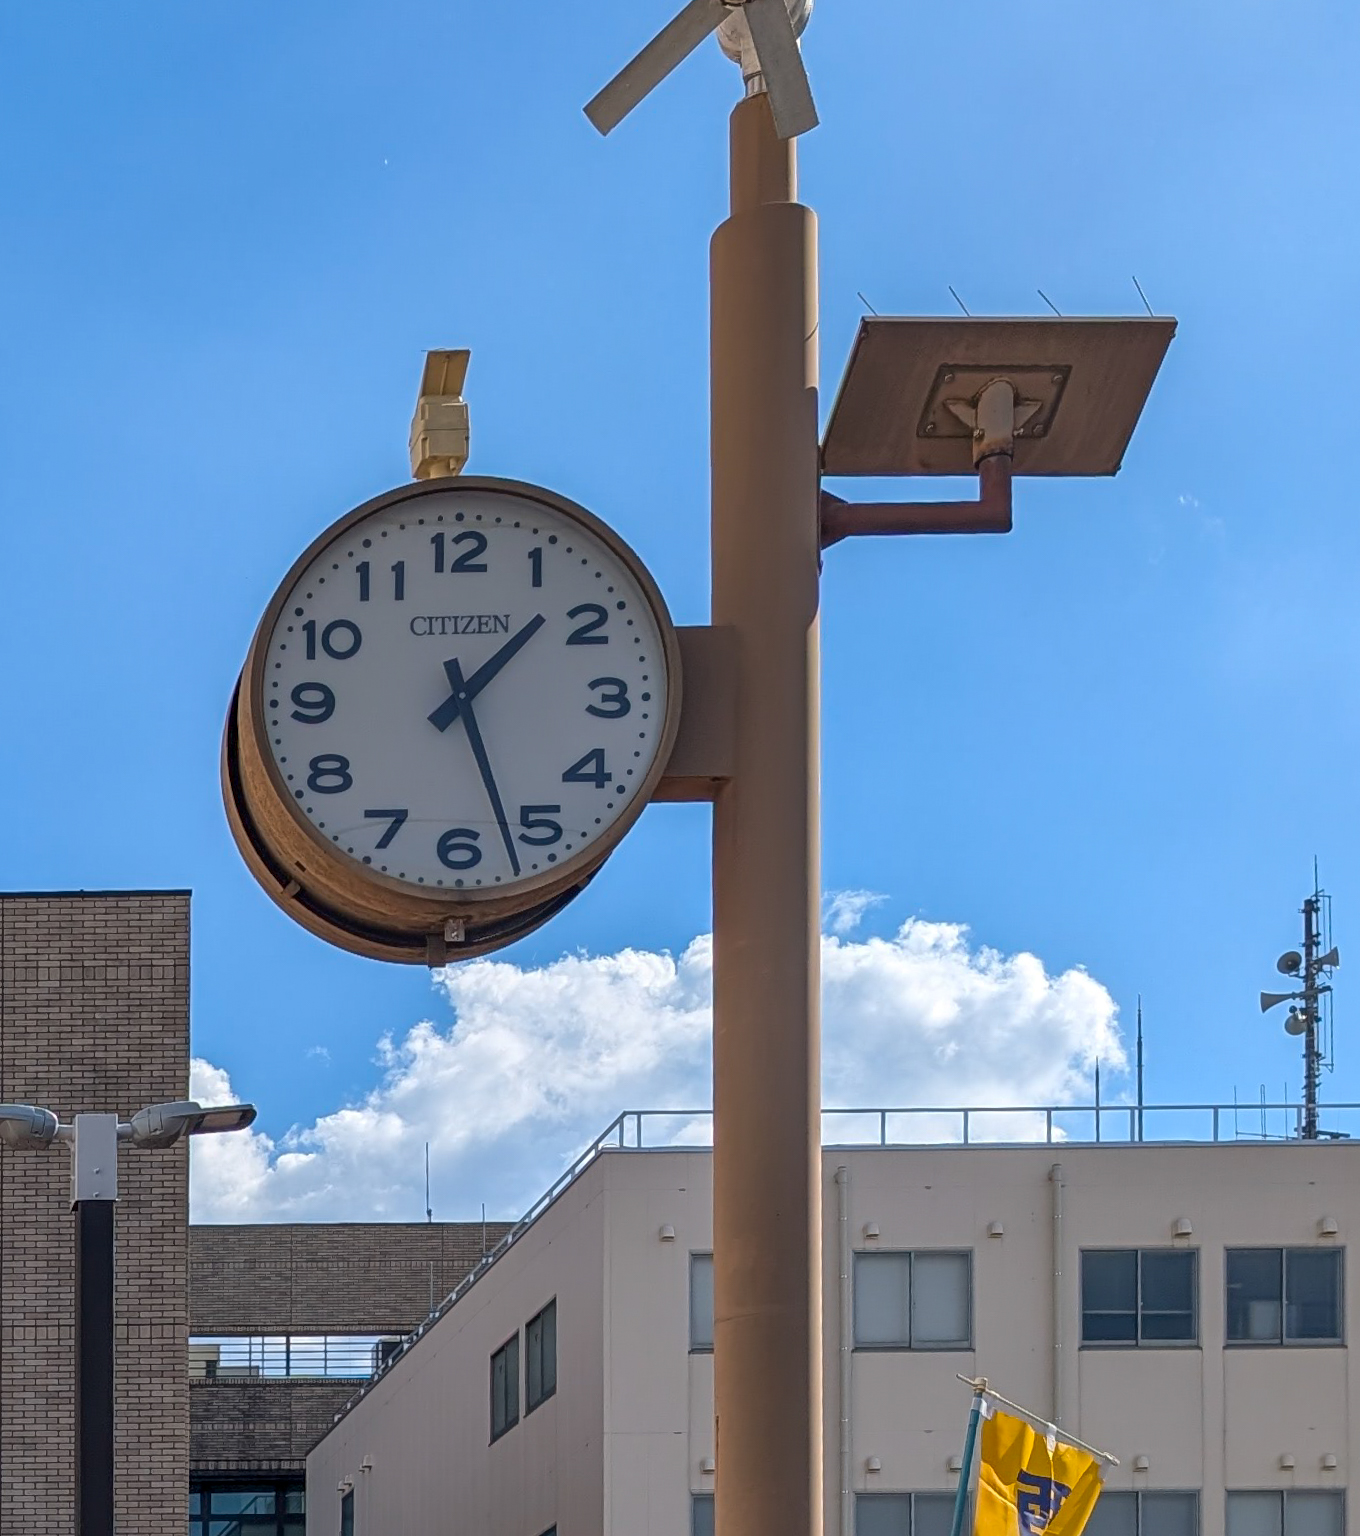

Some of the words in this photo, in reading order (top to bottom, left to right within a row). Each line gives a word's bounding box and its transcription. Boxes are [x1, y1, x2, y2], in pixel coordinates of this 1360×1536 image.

[430, 530, 488, 573] 12
[527, 547, 542, 587] 1
[355, 561, 406, 601] 11
[301, 619, 362, 660] 10
[409, 614, 511, 637] CITIZEN
[565, 603, 609, 645] 2
[290, 682, 335, 724] 9
[585, 677, 631, 719] 3
[307, 753, 353, 794] 8
[561, 748, 612, 789] 4
[363, 808, 409, 849] 7
[518, 804, 563, 846] 5
[436, 828, 481, 870] 6
